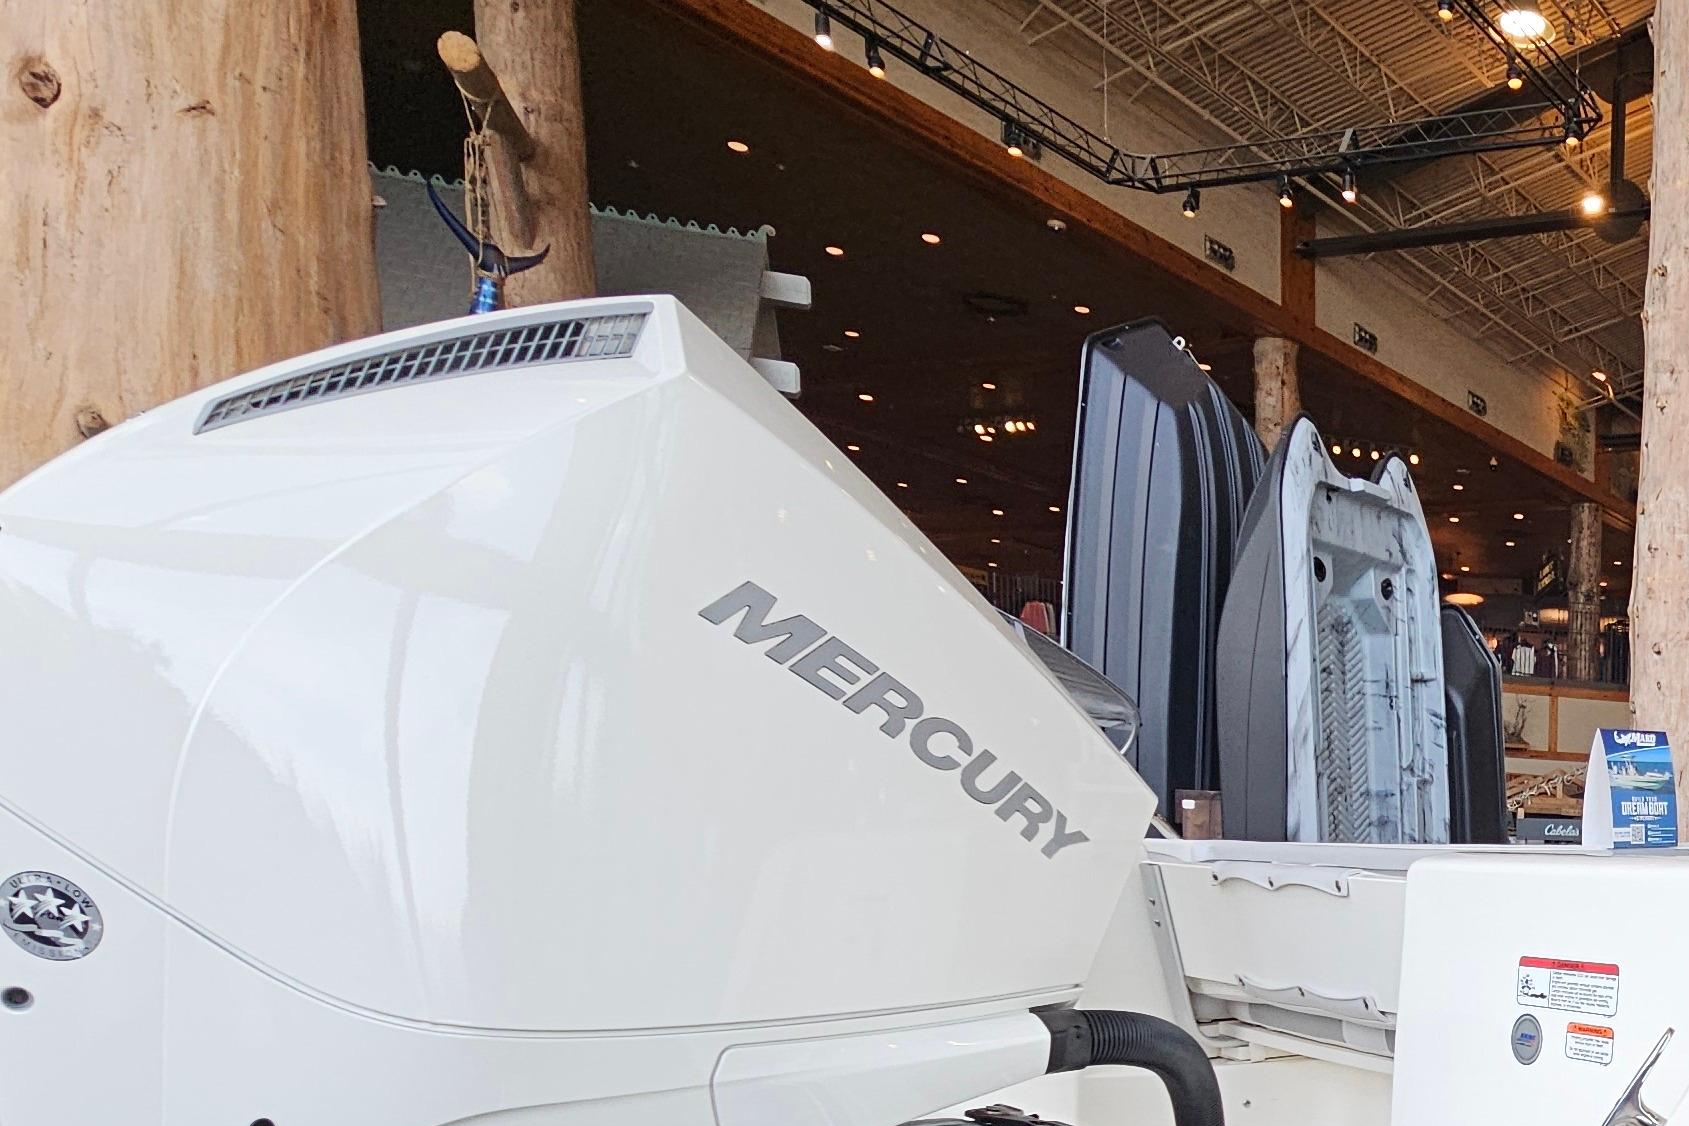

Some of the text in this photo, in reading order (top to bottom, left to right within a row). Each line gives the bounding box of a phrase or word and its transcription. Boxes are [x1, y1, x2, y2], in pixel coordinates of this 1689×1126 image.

[698, 580, 1091, 860] MERCURY
[1621, 801, 1668, 815] DREAM BOAT
